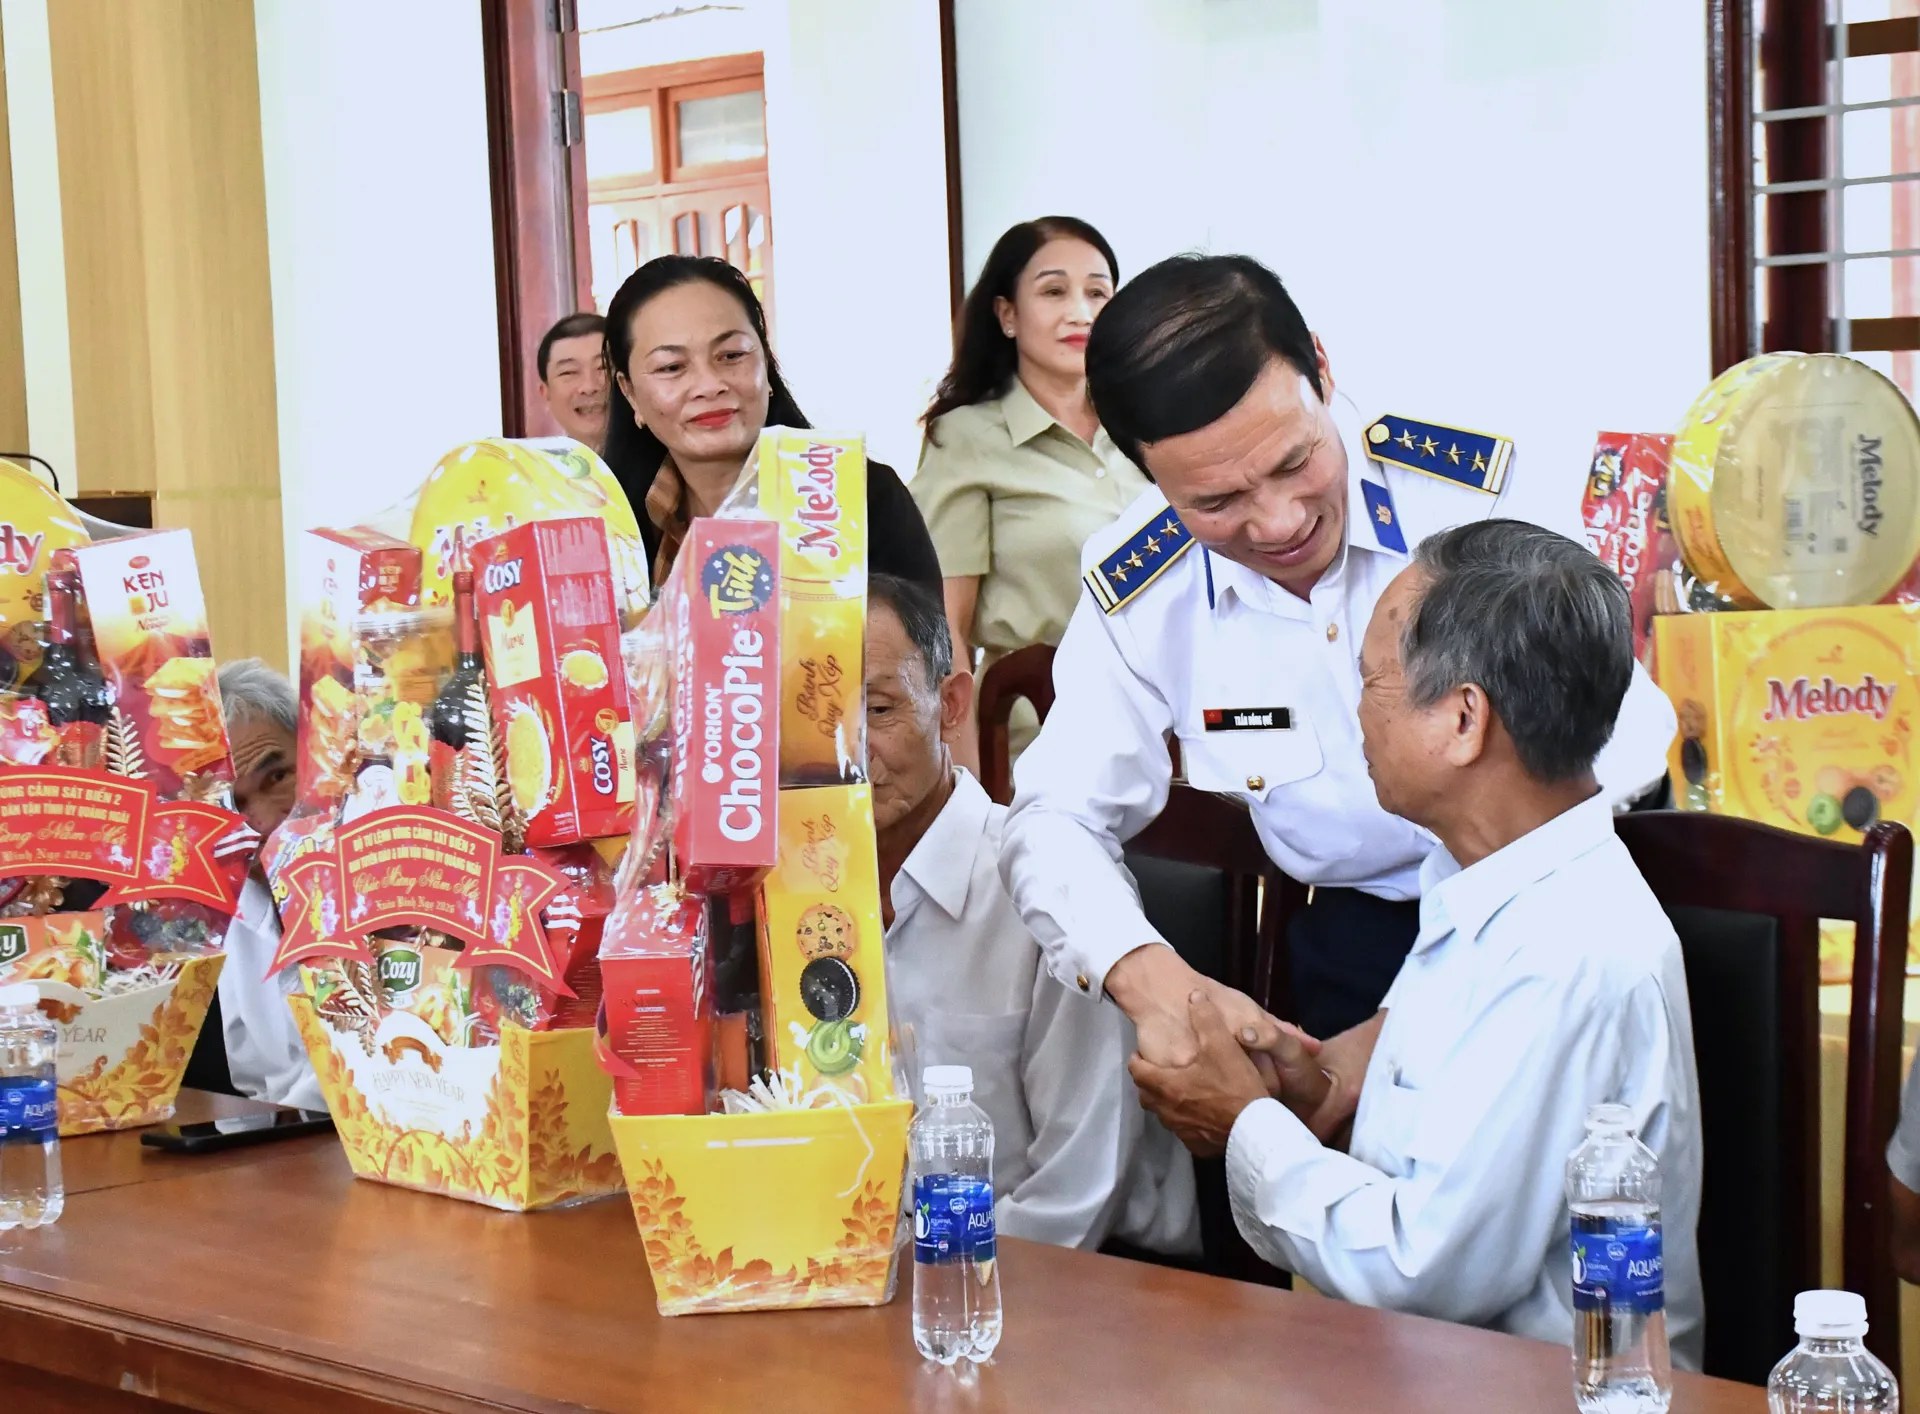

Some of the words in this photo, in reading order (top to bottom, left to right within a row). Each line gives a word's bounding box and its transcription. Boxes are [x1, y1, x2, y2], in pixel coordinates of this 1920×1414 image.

[797, 442, 843, 557] Melody
[1857, 434, 1883, 538] Melody
[123, 570, 165, 593] KEN
[485, 557, 523, 594] COSY
[146, 590, 169, 612] JU
[1763, 674, 1896, 720] Melody
[705, 688, 723, 758] ORION
[719, 629, 763, 842] ChocoPie
[590, 736, 614, 794] COSY
[62, 785, 83, 799] SÁT
[113, 794, 122, 806] 2
[469, 842, 476, 855] 2
[381, 957, 417, 985] Cozy
[62, 1025, 107, 1043] YEAR
[436, 1076, 465, 1103] YEAR
